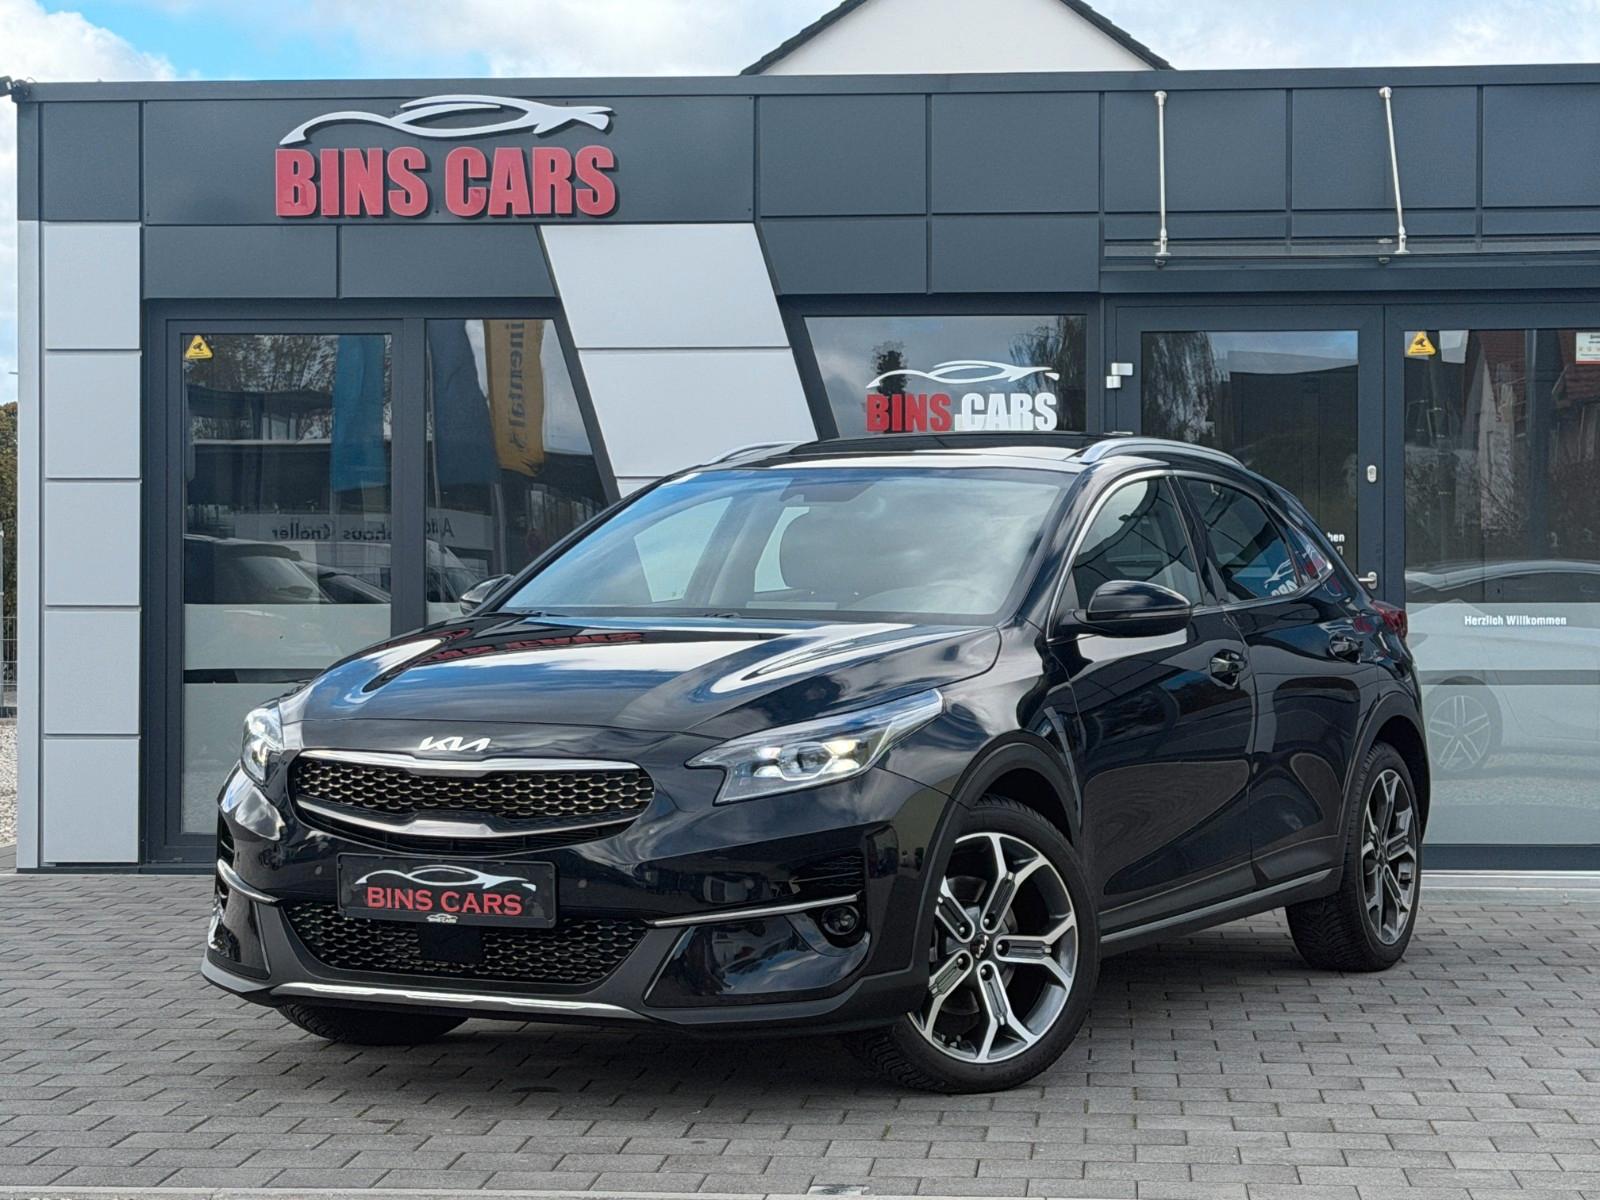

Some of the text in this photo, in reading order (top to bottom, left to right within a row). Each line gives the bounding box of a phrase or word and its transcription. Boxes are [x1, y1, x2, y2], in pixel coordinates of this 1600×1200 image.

[275, 145, 616, 217] BINS CARS
[866, 392, 1058, 432] BINS CARS
[1327, 531, 1345, 543] hen
[1464, 615, 1567, 627] Herzlich Willkommen
[419, 736, 491, 752] KIA
[366, 886, 523, 917] BINS CARS
